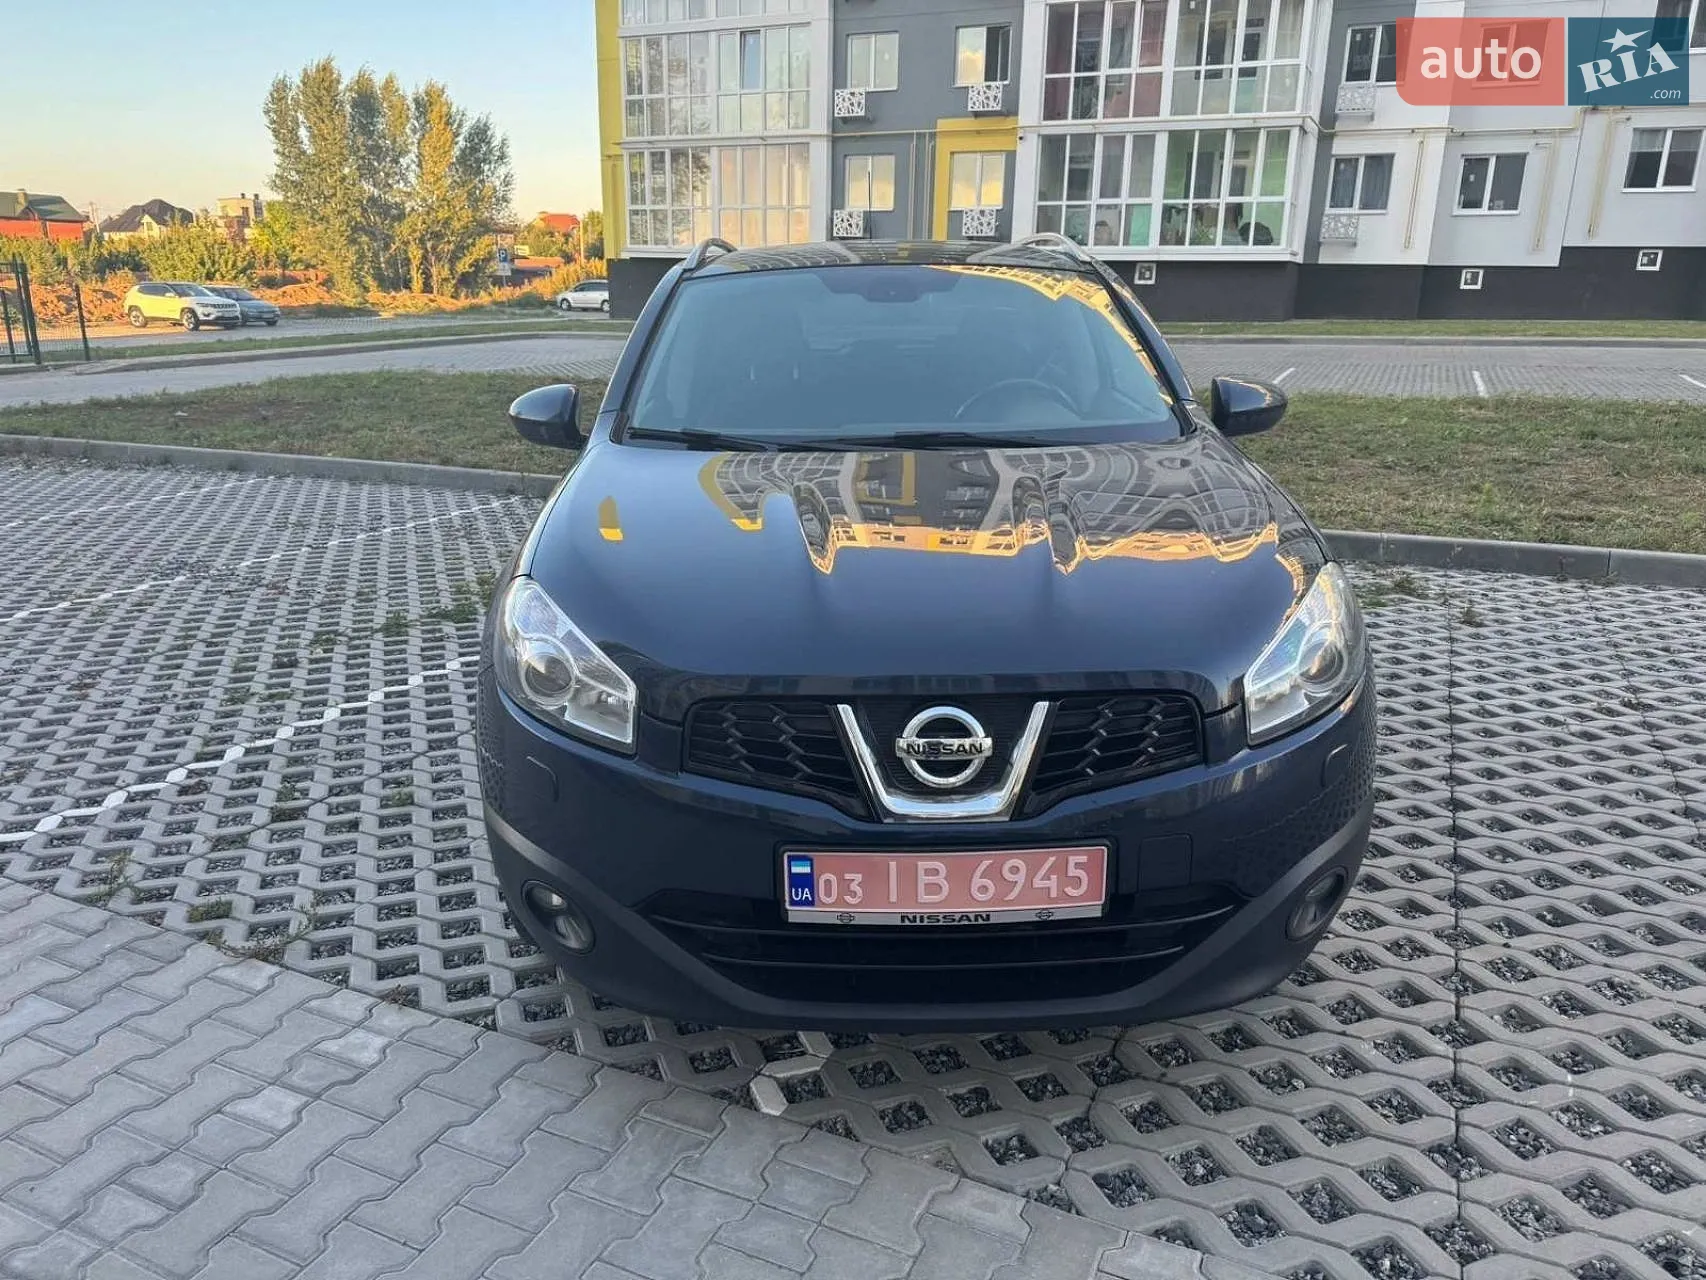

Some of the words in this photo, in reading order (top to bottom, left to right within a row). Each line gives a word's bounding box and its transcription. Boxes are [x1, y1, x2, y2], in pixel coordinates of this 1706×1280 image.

[905, 743, 983, 755] NISSAN
[818, 873, 863, 905] 03
[888, 861, 950, 903] IB
[970, 855, 1089, 902] 6945
[791, 887, 812, 901] UA
[900, 912, 991, 924] NISSAN
